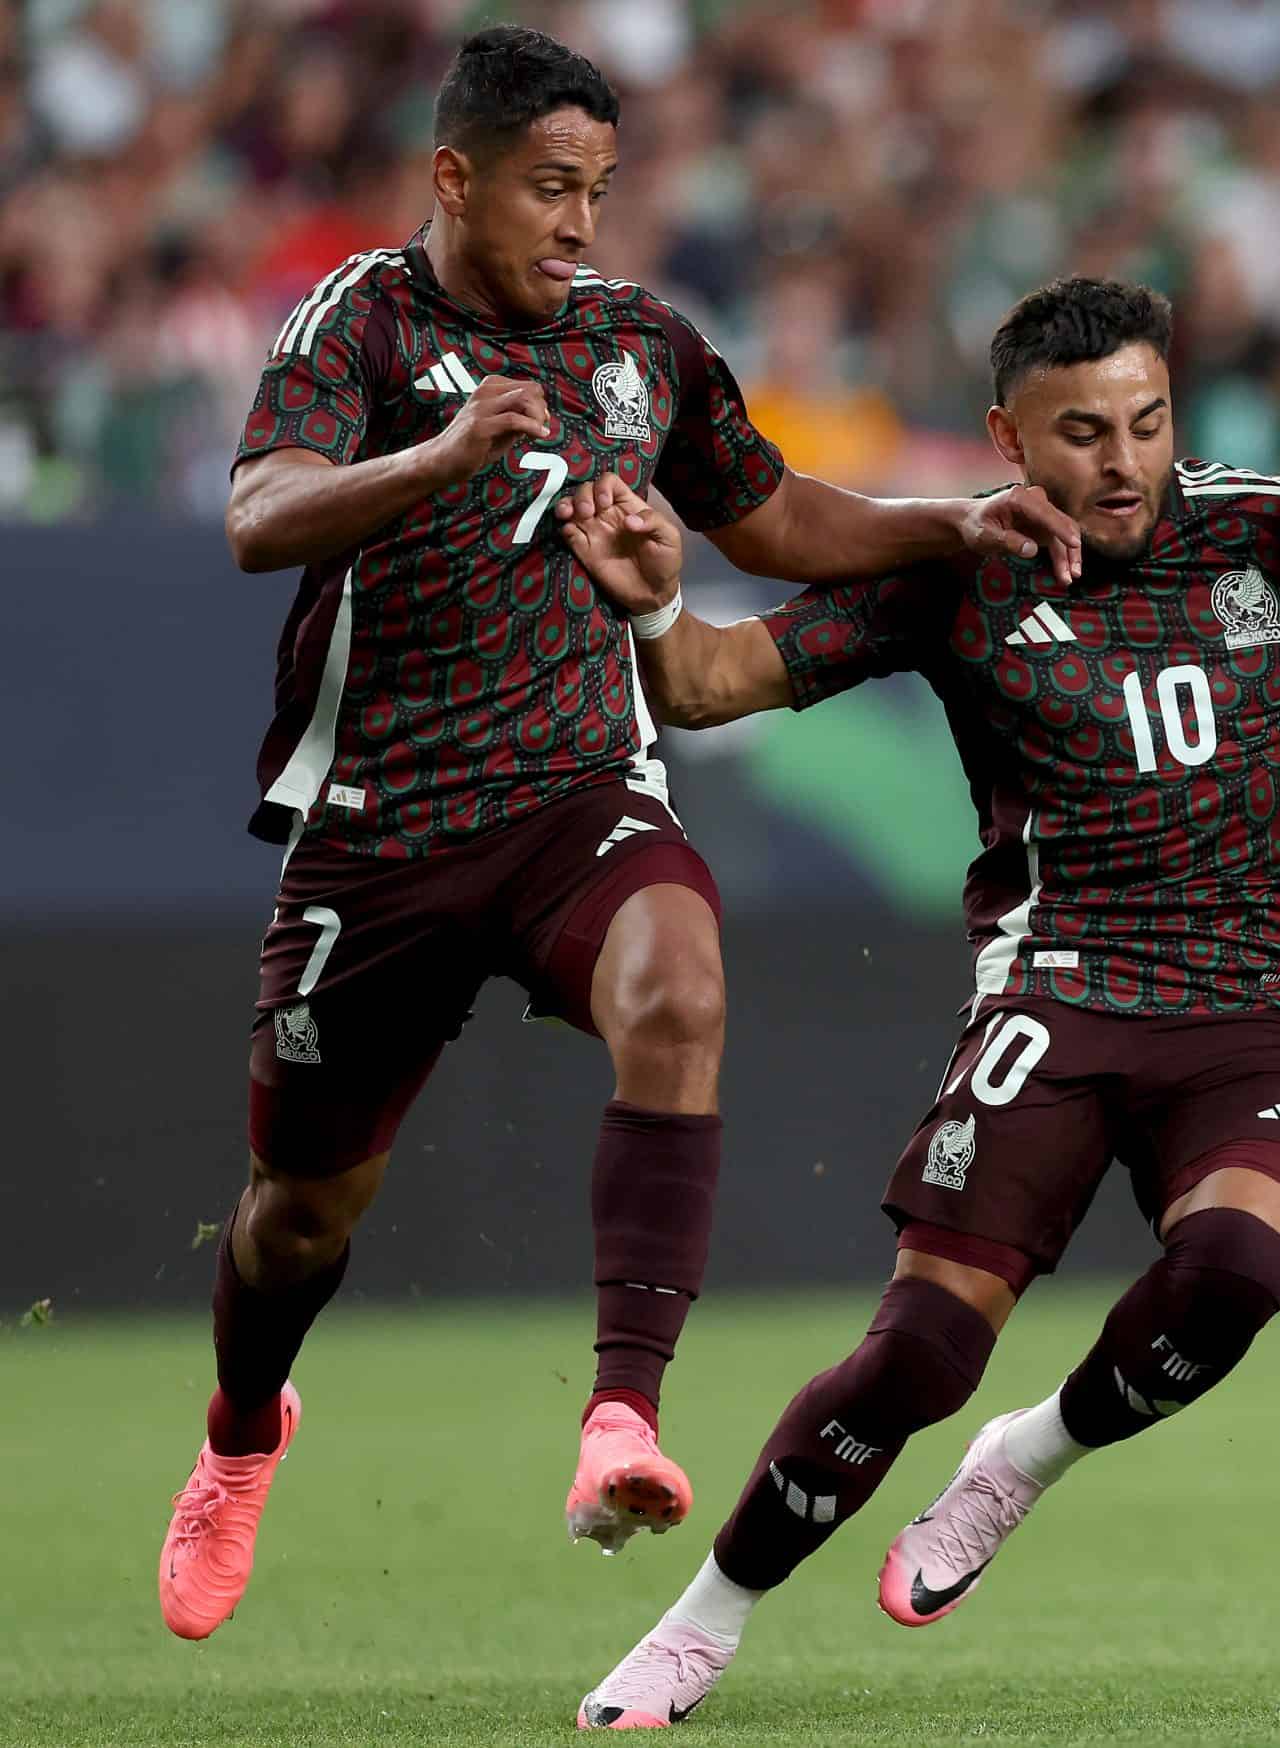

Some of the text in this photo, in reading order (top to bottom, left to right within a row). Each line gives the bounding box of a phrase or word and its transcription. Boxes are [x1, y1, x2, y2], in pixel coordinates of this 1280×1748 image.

[511, 451, 569, 544] 7
[1122, 663, 1217, 773] 10
[297, 905, 342, 997] 7
[1151, 1334, 1213, 1381] FMF
[820, 1419, 883, 1465] FMF
